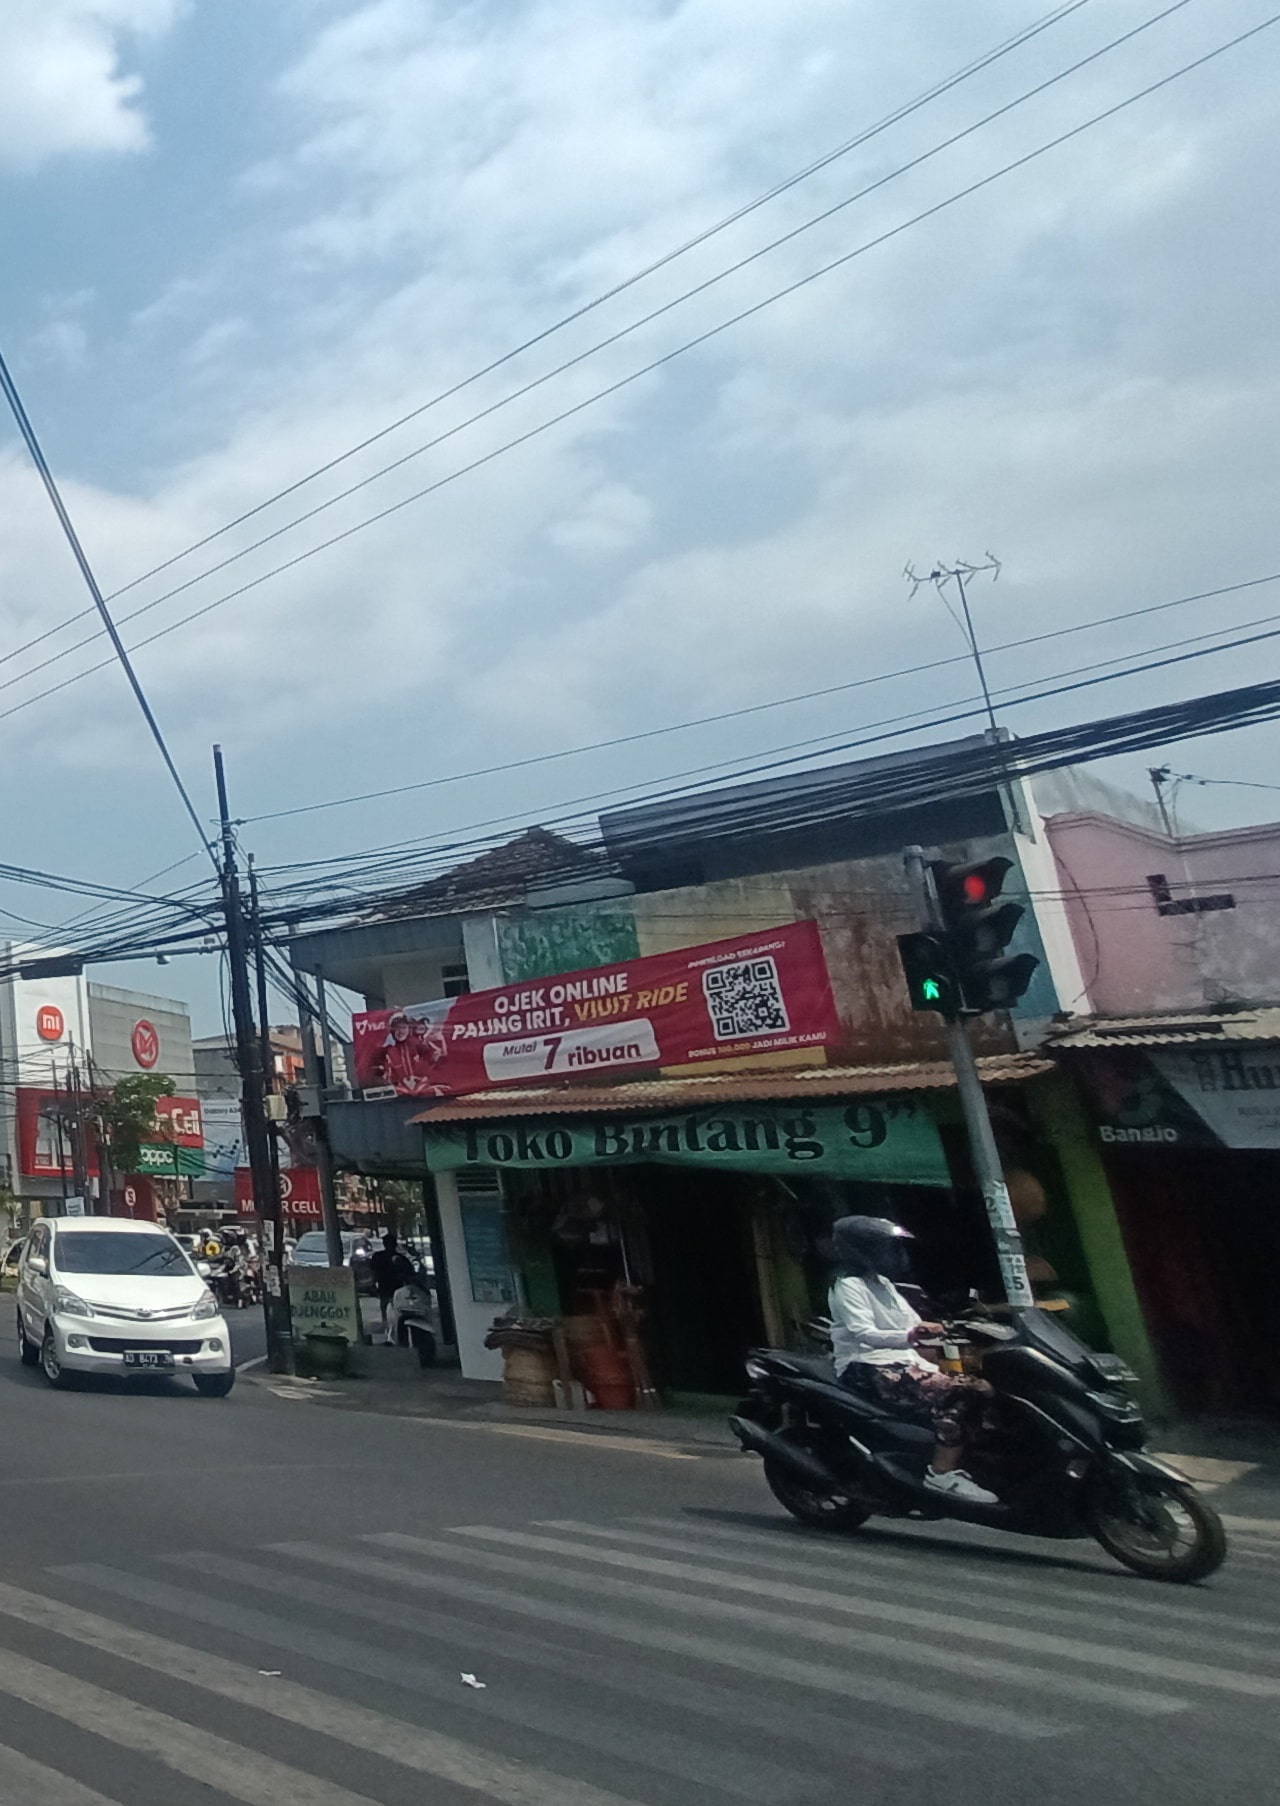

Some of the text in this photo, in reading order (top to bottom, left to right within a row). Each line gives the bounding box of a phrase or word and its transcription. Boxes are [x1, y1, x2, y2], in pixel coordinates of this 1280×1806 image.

[452, 1016, 523, 1041] PALING
[525, 1006, 570, 1030] IRIT,
[635, 982, 690, 1010] RIDE
[494, 973, 629, 1015] OJEK ONLINE
[502, 1036, 642, 1070] Mulai 7 ribuan
[752, 1039, 773, 1050] JADI
[773, 1036, 798, 1047] MILIK
[799, 1031, 827, 1043] KAMU
[594, 1109, 825, 1161] Bintang
[291, 1200, 320, 1214] CELL
